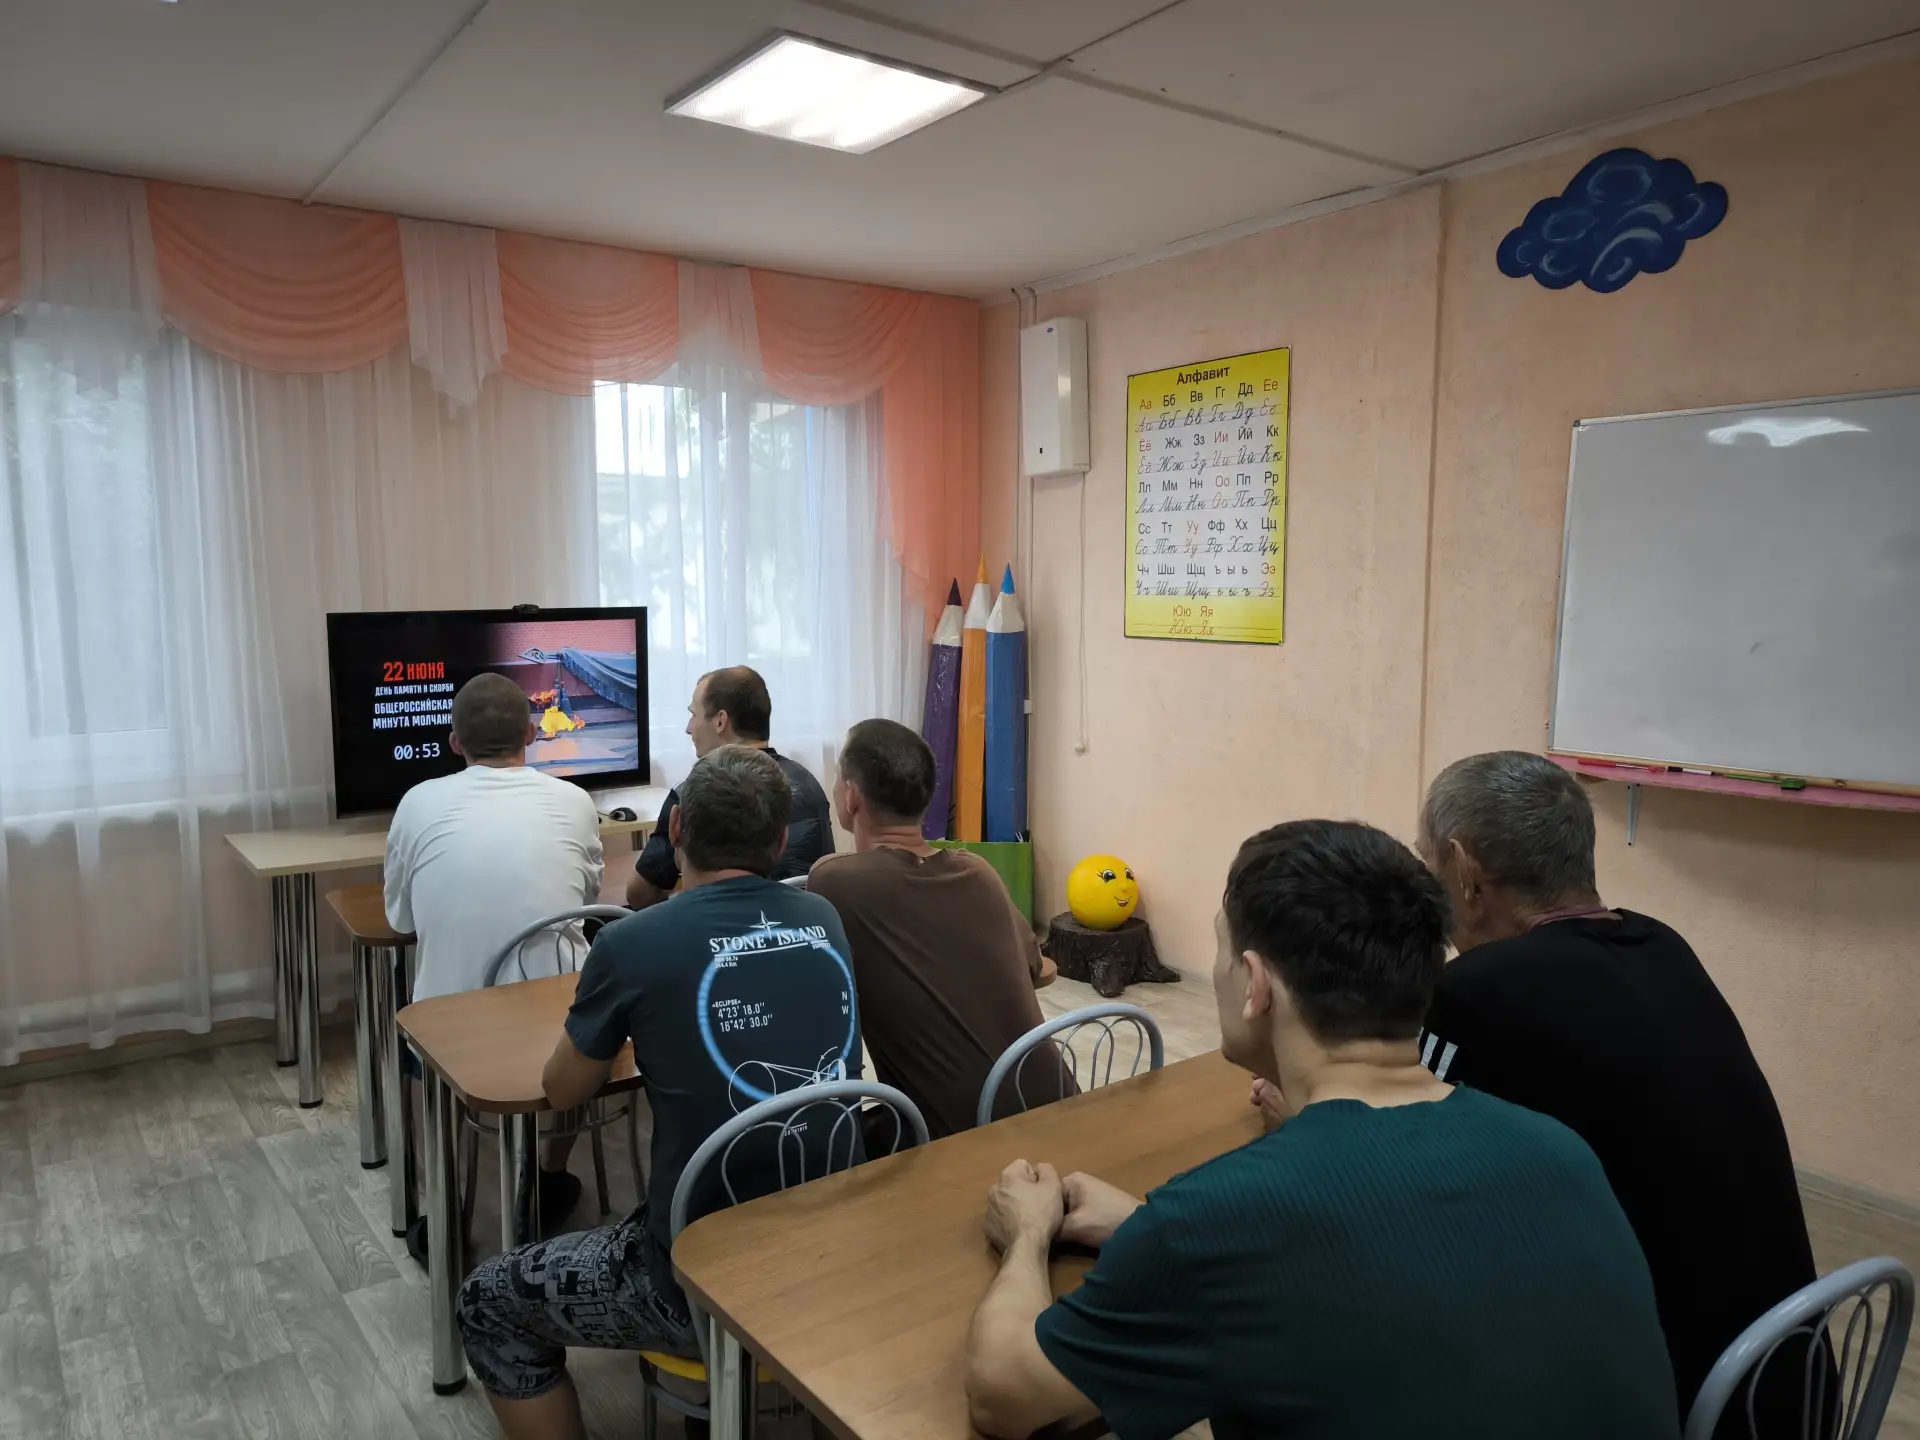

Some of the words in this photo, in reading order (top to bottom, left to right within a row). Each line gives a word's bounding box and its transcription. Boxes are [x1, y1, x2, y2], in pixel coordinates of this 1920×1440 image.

[1176, 366, 1230, 385] Алфавит
[1140, 399, 1151, 411] Аа
[1163, 394, 1175, 407] Бб
[1190, 391, 1203, 402] Вв
[1216, 387, 1226, 398] Гг
[1238, 383, 1253, 398] Дд
[1264, 379, 1278, 391] Ее
[1139, 439, 1151, 452] Ёё
[1165, 437, 1182, 449] Жж
[1194, 434, 1205, 446] Зз
[1215, 431, 1228, 443] Ии
[1238, 426, 1252, 440] Йй
[1267, 425, 1279, 437] Кк
[1139, 482, 1151, 493] Лл
[1162, 480, 1178, 491] Мм
[1190, 478, 1203, 489] Нн
[1216, 475, 1229, 487] Оо
[1236, 473, 1251, 486] Пп
[1265, 471, 1279, 486] Рр
[1138, 523, 1151, 534] Сс
[1162, 522, 1172, 533] Тт
[1187, 521, 1199, 534] Уу
[1207, 519, 1225, 533] Фф
[1235, 518, 1248, 530] Хх
[1261, 517, 1277, 532] Цц
[1138, 564, 1150, 575] Чч
[1158, 563, 1175, 575] Шш
[1187, 563, 1205, 577] Щщ
[1215, 565, 1221, 575] ъ
[1227, 565, 1235, 575] ы
[1242, 565, 1248, 575] ь
[1261, 562, 1276, 575] Ээ
[1173, 605, 1191, 617] Юю
[1200, 606, 1214, 617] Яя
[384, 662, 404, 682] 22
[407, 662, 445, 680] ИЮНЯ
[375, 686, 392, 697] ДЕНЬ
[394, 684, 422, 695] ПАМЯТИ
[423, 684, 428, 693] И
[429, 683, 454, 693] СКОРБИ
[374, 698, 453, 715] ОБЩЕРОССИЙСКАЯ
[372, 716, 410, 730] МИНУТА
[412, 714, 453, 727] МОЛЧАНИ
[394, 742, 440, 760] 00:53
[709, 934, 767, 952] STONE
[776, 925, 826, 946] ISLAND
[842, 991, 848, 1000] N
[842, 1005, 848, 1014] W
